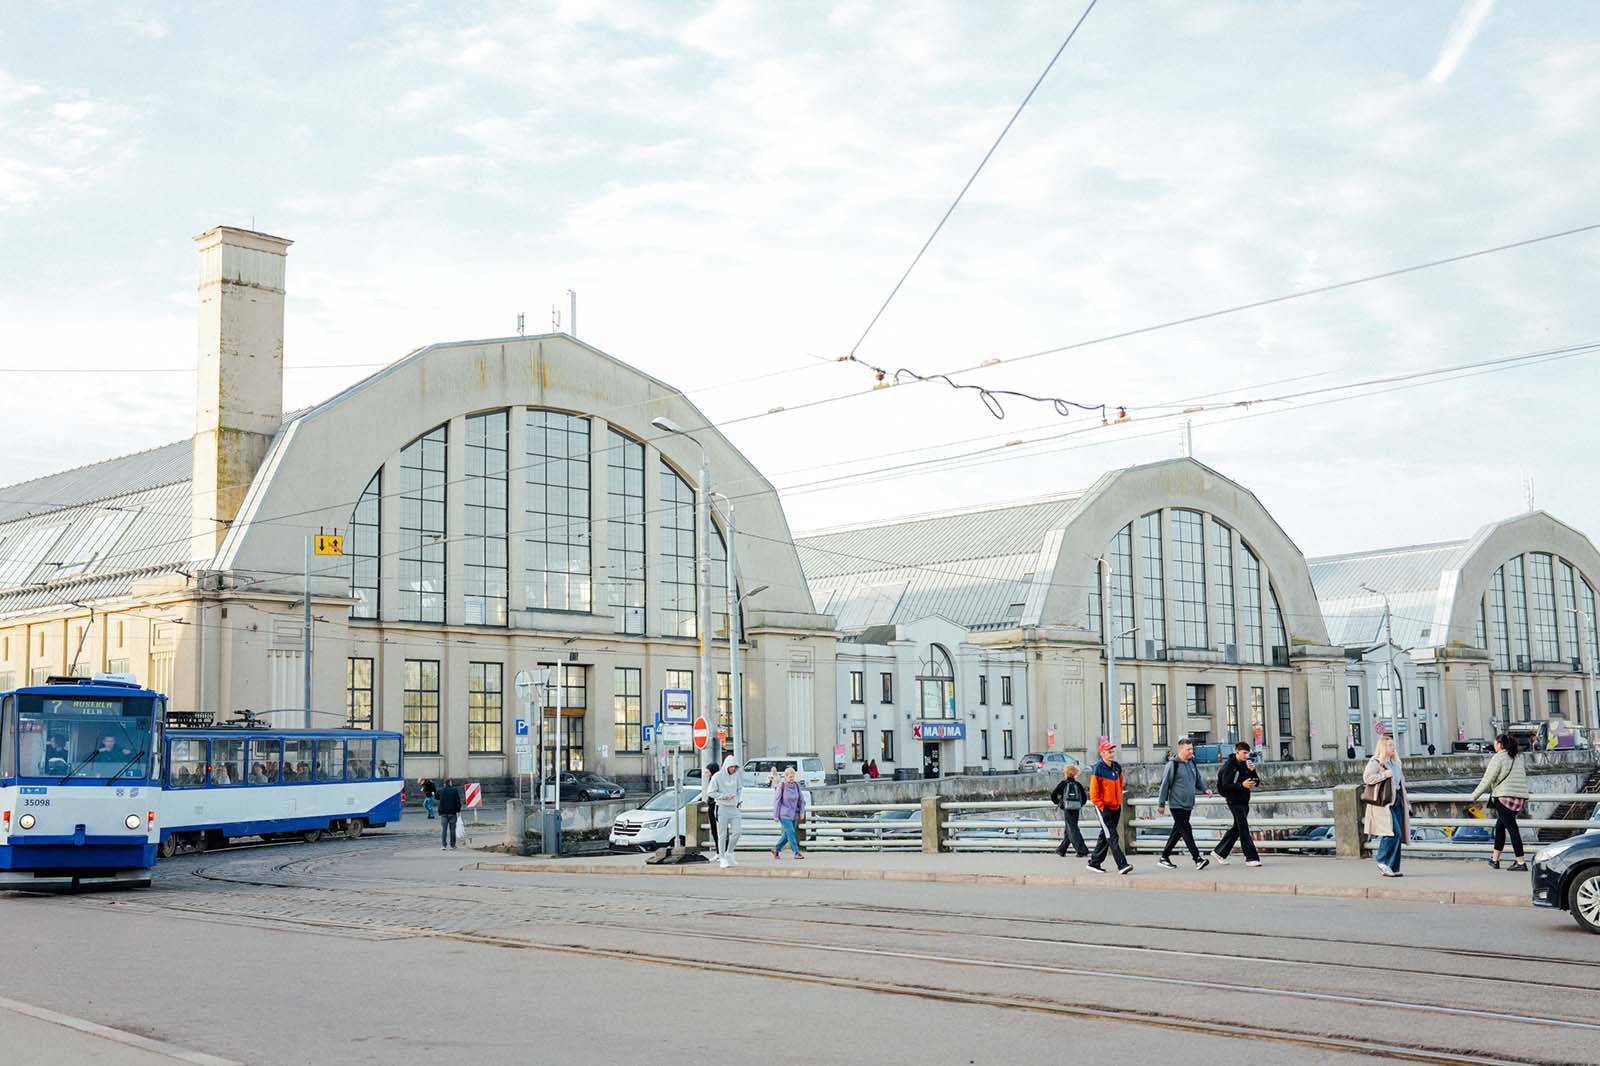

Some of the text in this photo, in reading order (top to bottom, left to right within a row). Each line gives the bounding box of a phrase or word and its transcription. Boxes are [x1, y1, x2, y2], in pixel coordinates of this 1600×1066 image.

[52, 700, 62, 713] 7
[517, 720, 526, 733] P
[913, 725, 921, 737] X
[24, 799, 50, 807] 35098
